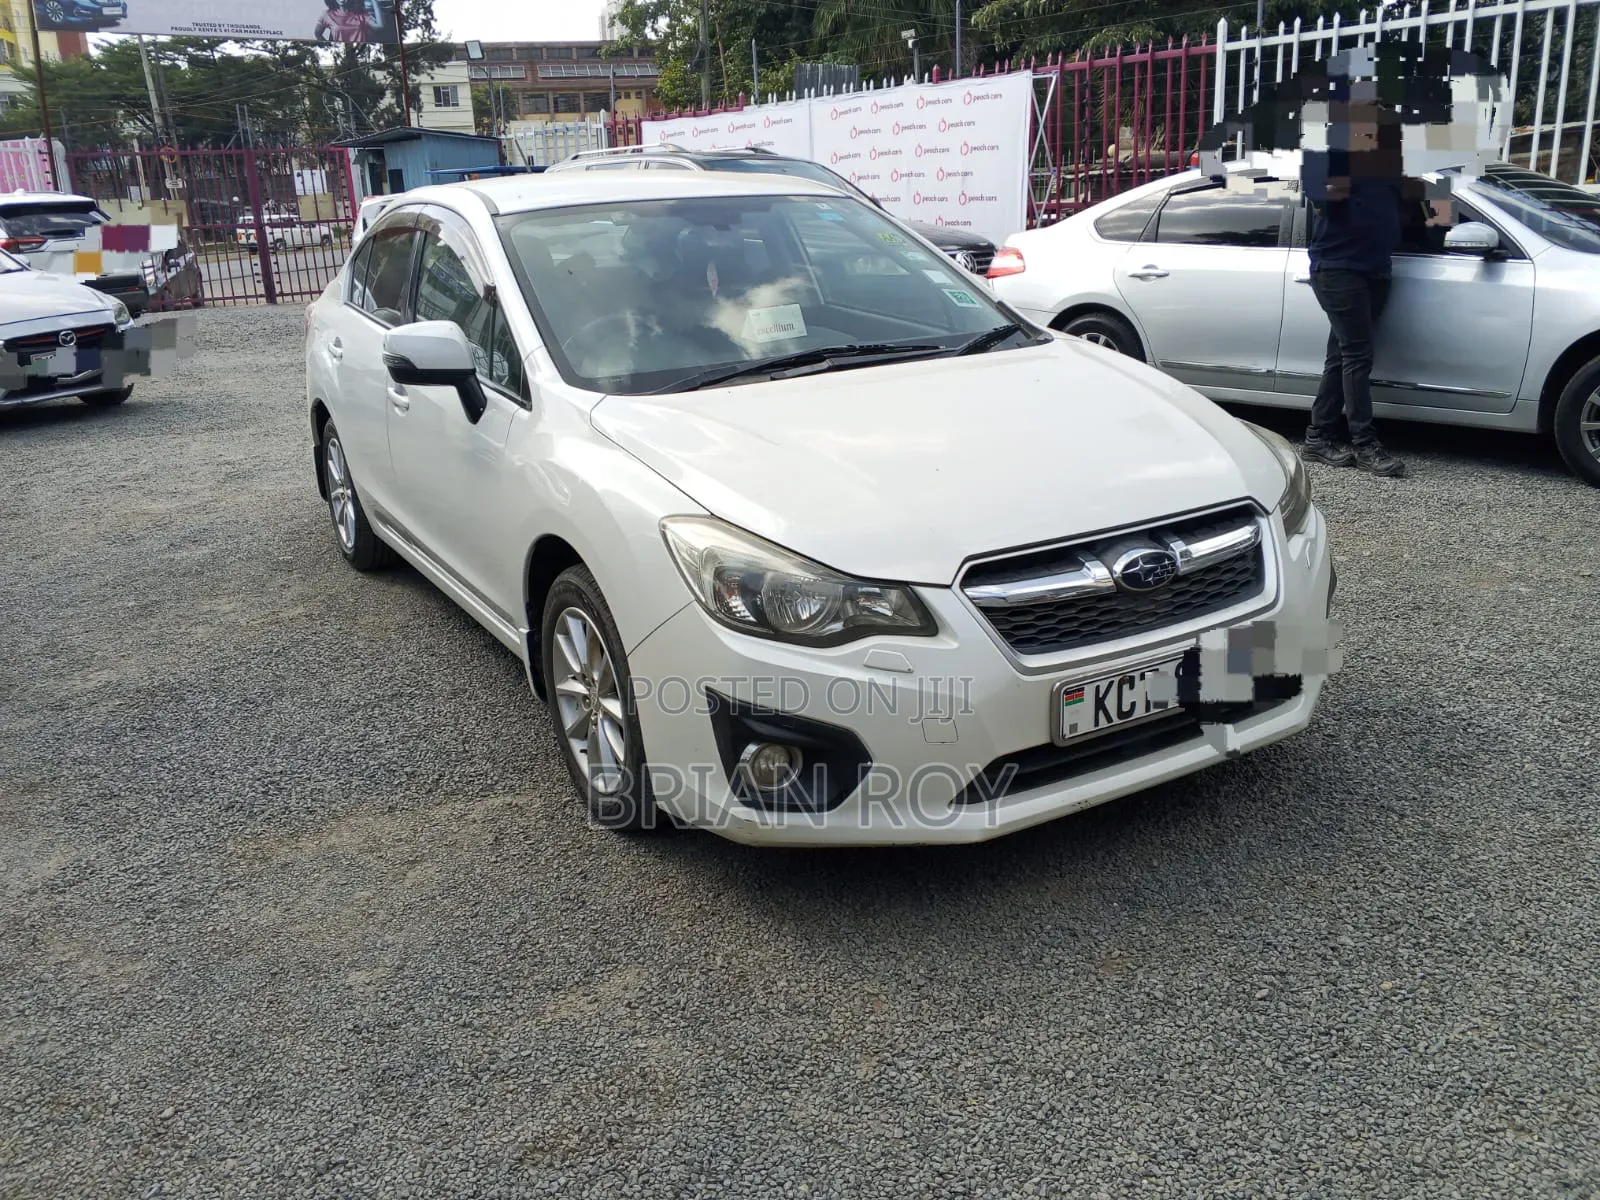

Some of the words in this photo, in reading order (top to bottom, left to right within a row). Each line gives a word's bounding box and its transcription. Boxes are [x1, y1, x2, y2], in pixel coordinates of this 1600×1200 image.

[973, 93, 989, 102] peach
[926, 99, 940, 107] peach
[879, 104, 891, 112] peach
[839, 108, 851, 118] peach
[901, 124, 915, 132] peach
[948, 122, 963, 130] peach
[858, 128, 871, 136] peach
[970, 144, 986, 153] peach
[878, 150, 891, 158] peach
[900, 171, 914, 179] peach
[922, 194, 935, 202] peach
[968, 194, 984, 202] peach
[945, 218, 958, 227] peach
